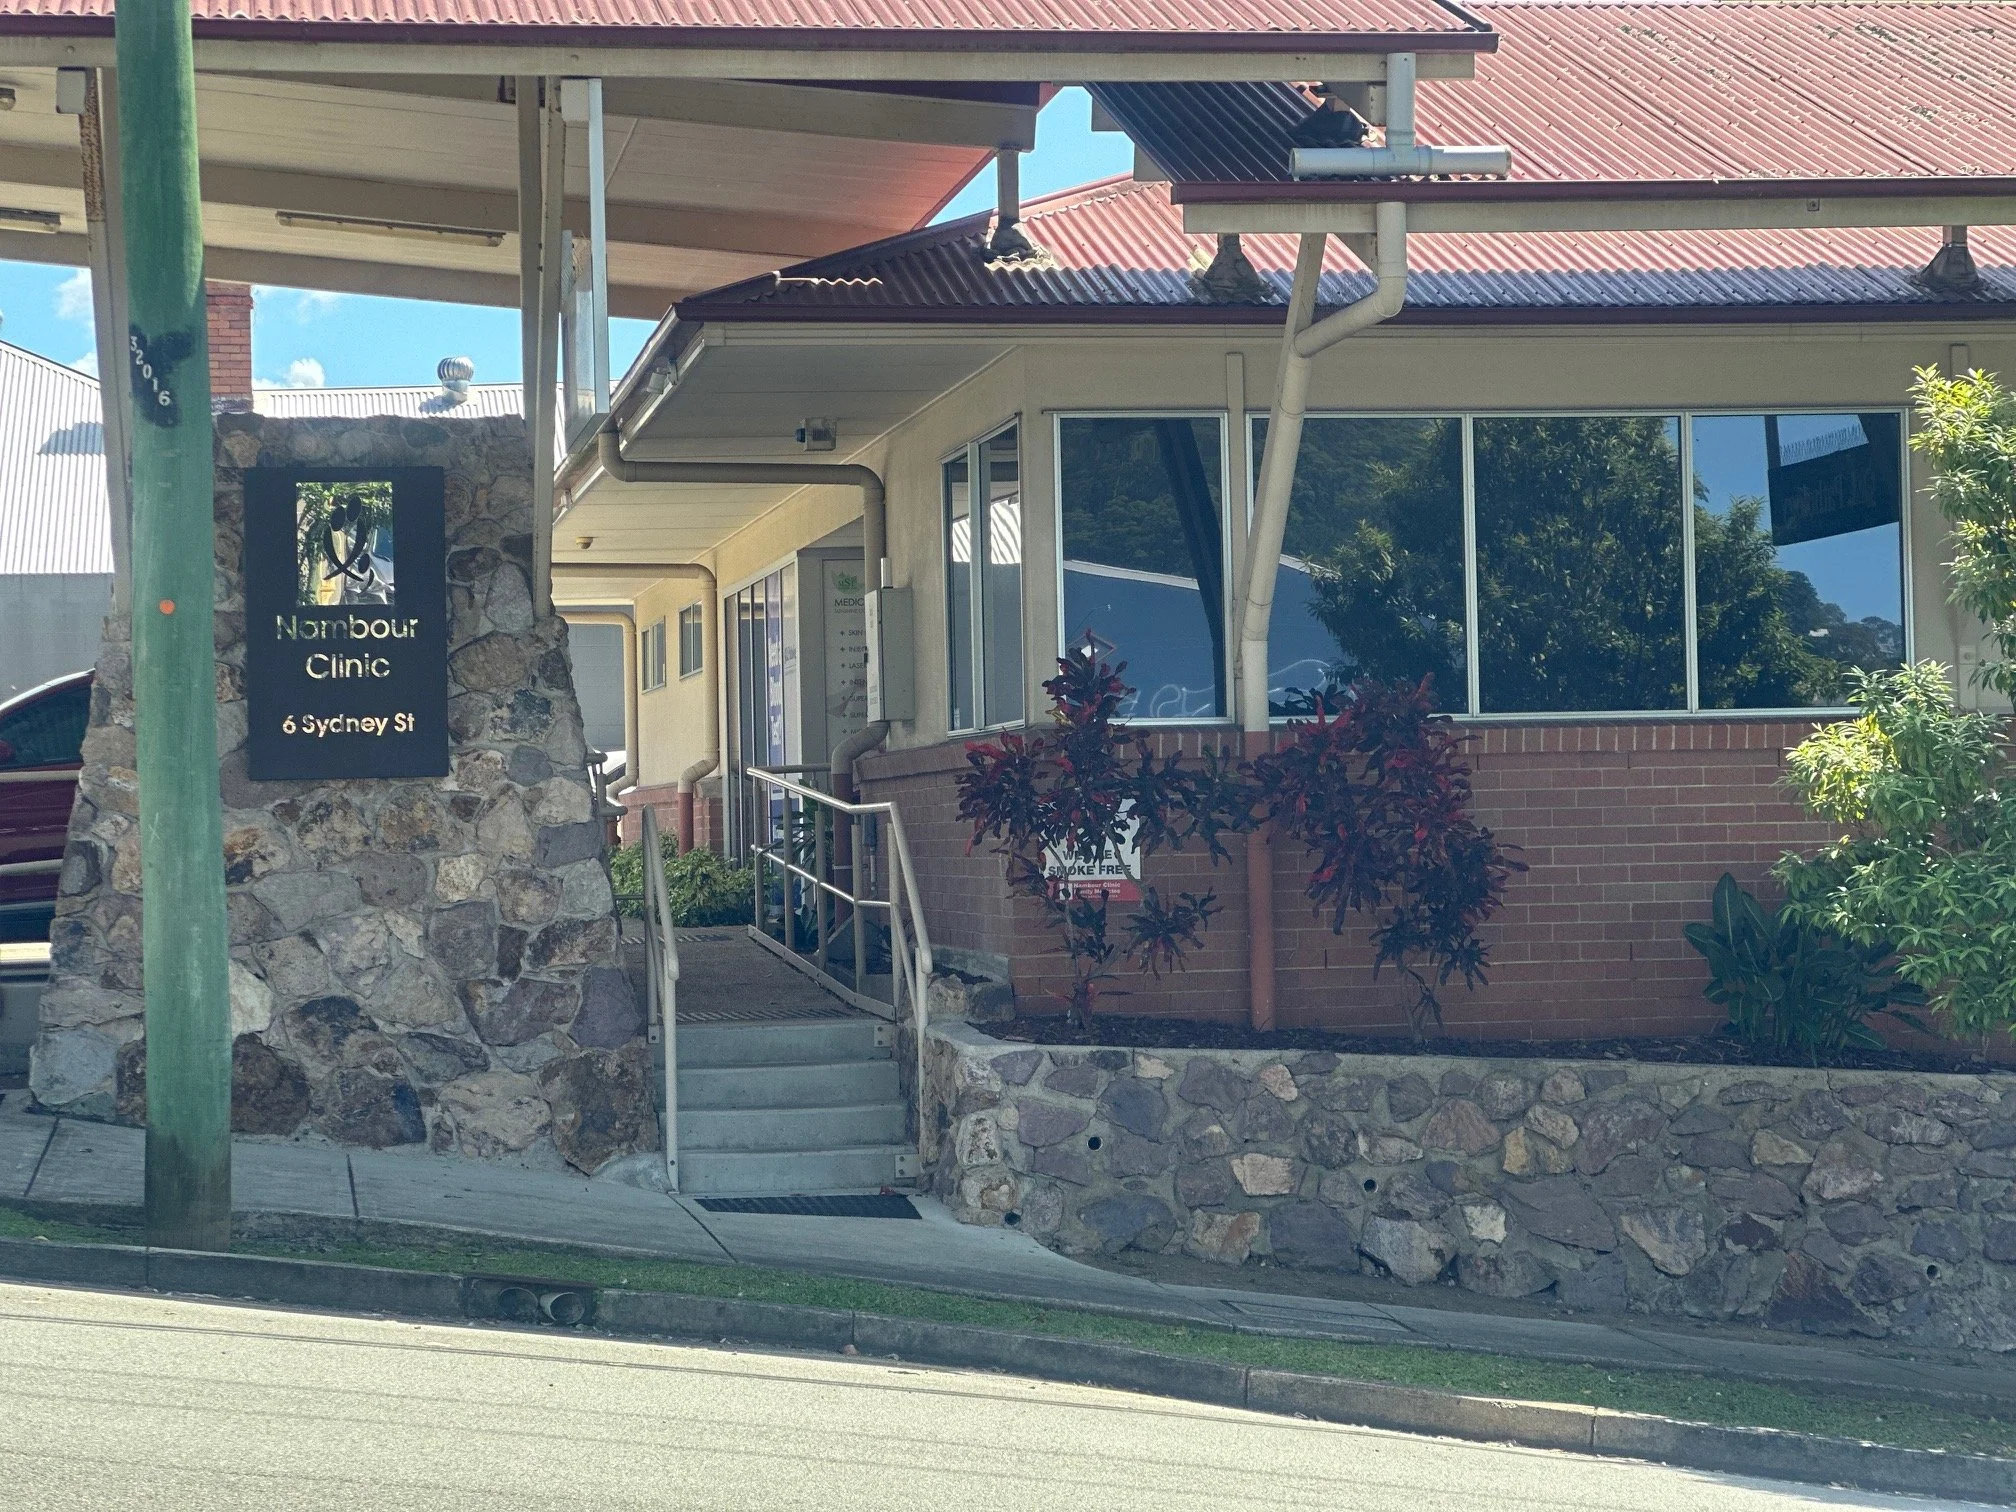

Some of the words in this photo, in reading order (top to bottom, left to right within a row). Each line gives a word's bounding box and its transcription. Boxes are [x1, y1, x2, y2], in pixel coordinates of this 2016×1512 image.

[276, 614, 419, 640] Nambour
[305, 653, 391, 679] Clinic
[282, 715, 297, 734] 6
[302, 713, 388, 738] Sydney
[394, 712, 416, 733] St
